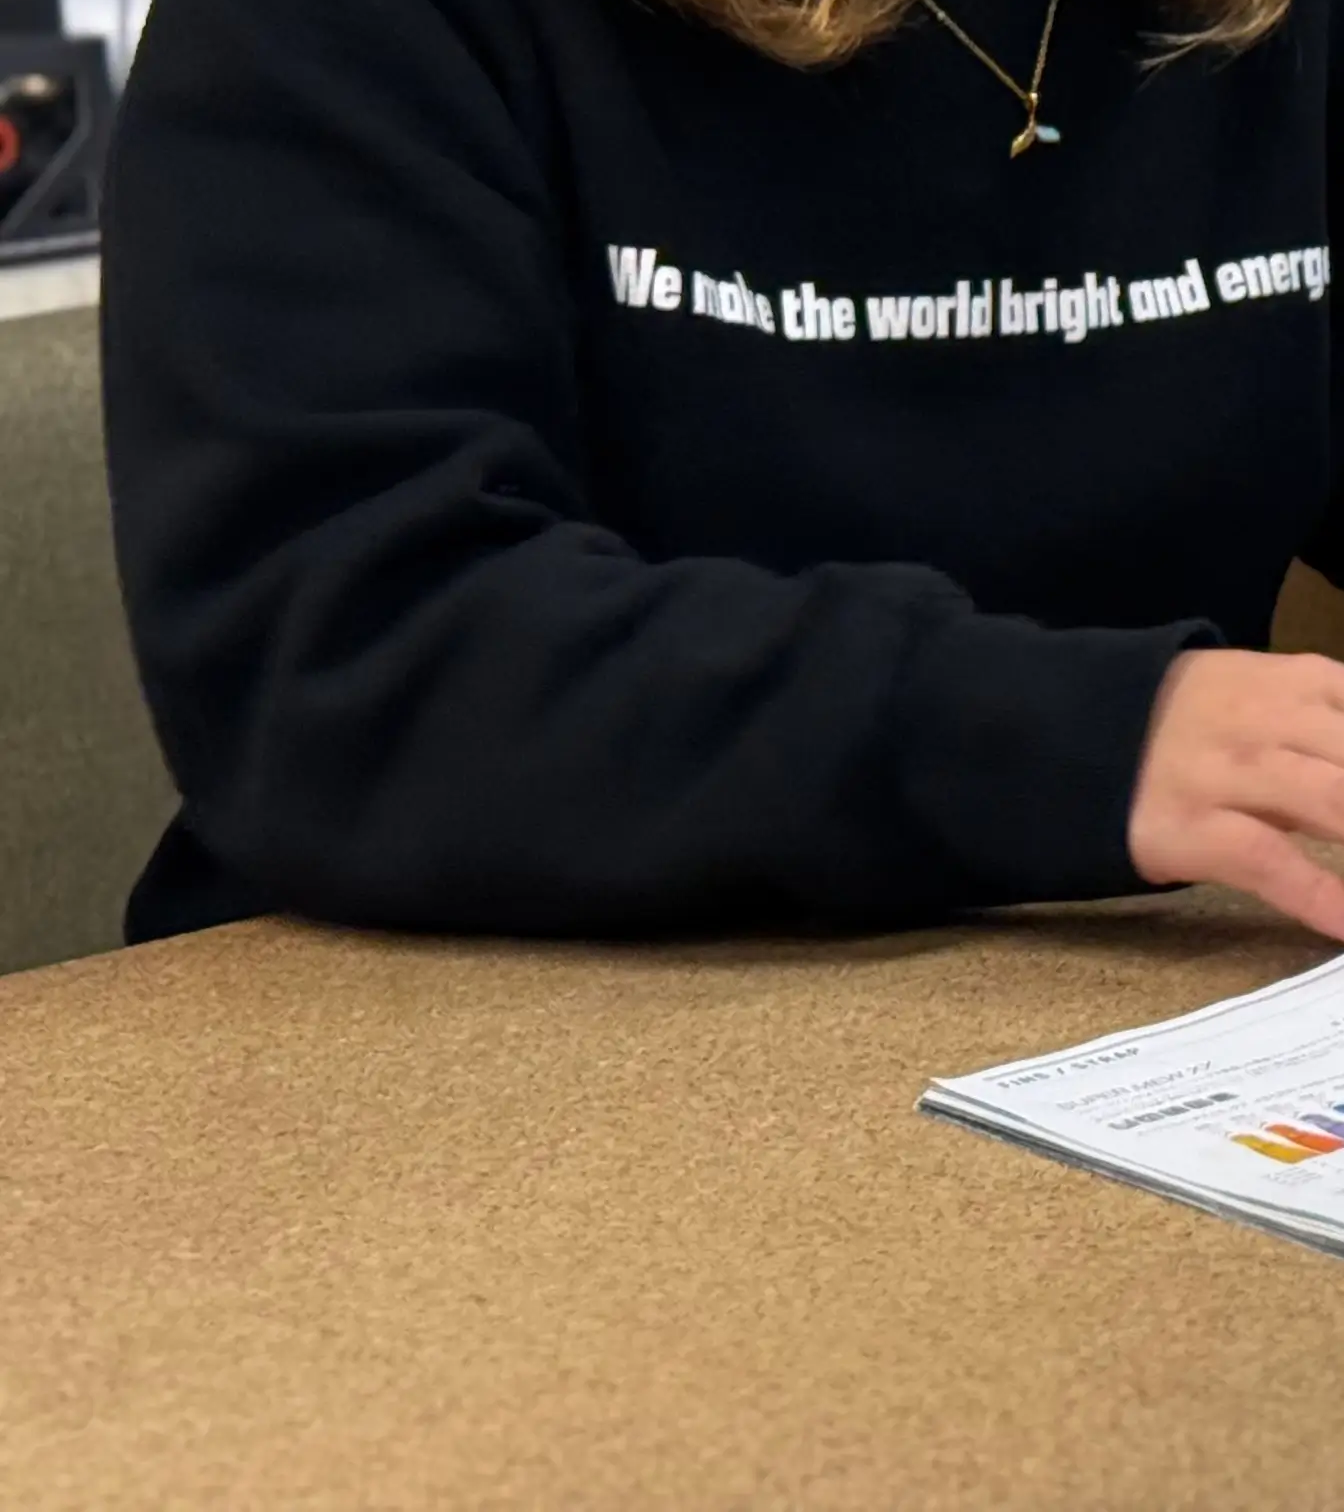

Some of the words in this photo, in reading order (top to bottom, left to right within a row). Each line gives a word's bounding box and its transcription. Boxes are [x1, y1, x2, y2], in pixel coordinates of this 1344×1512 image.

[607, 244, 683, 312] We
[780, 282, 856, 341] the
[866, 280, 993, 341] world
[1000, 272, 1125, 344] bright
[1128, 257, 1211, 323] and
[997, 1071, 1051, 1090] FINS
[1069, 1046, 1140, 1071] STRAP
